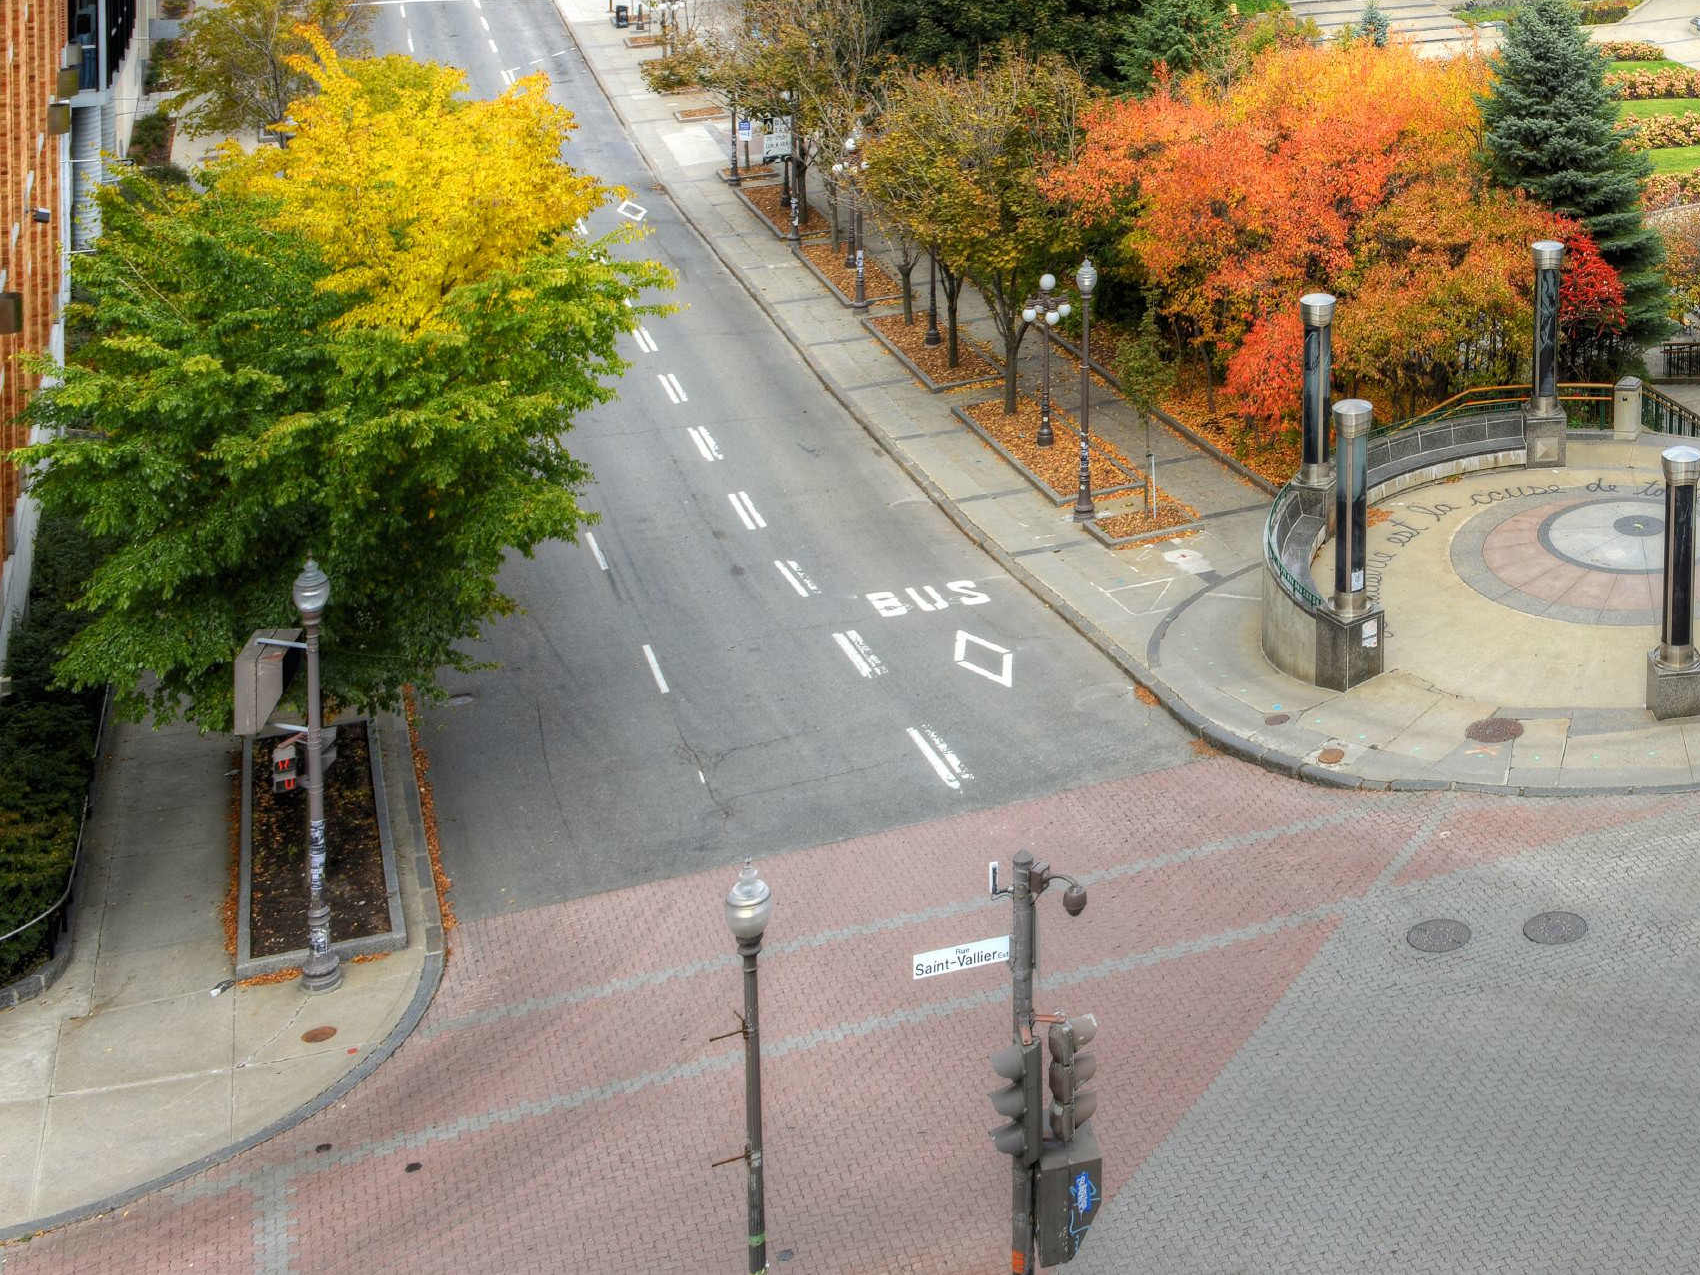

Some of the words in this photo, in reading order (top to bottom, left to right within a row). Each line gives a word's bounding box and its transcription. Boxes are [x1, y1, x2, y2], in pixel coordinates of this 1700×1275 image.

[1407, 503, 1462, 522] la
[1471, 484, 1567, 507] cause
[1586, 478, 1620, 493] de
[865, 580, 992, 617] BUS
[915, 950, 998, 976] Saint-Vallier
[955, 948, 970, 956] Rue
